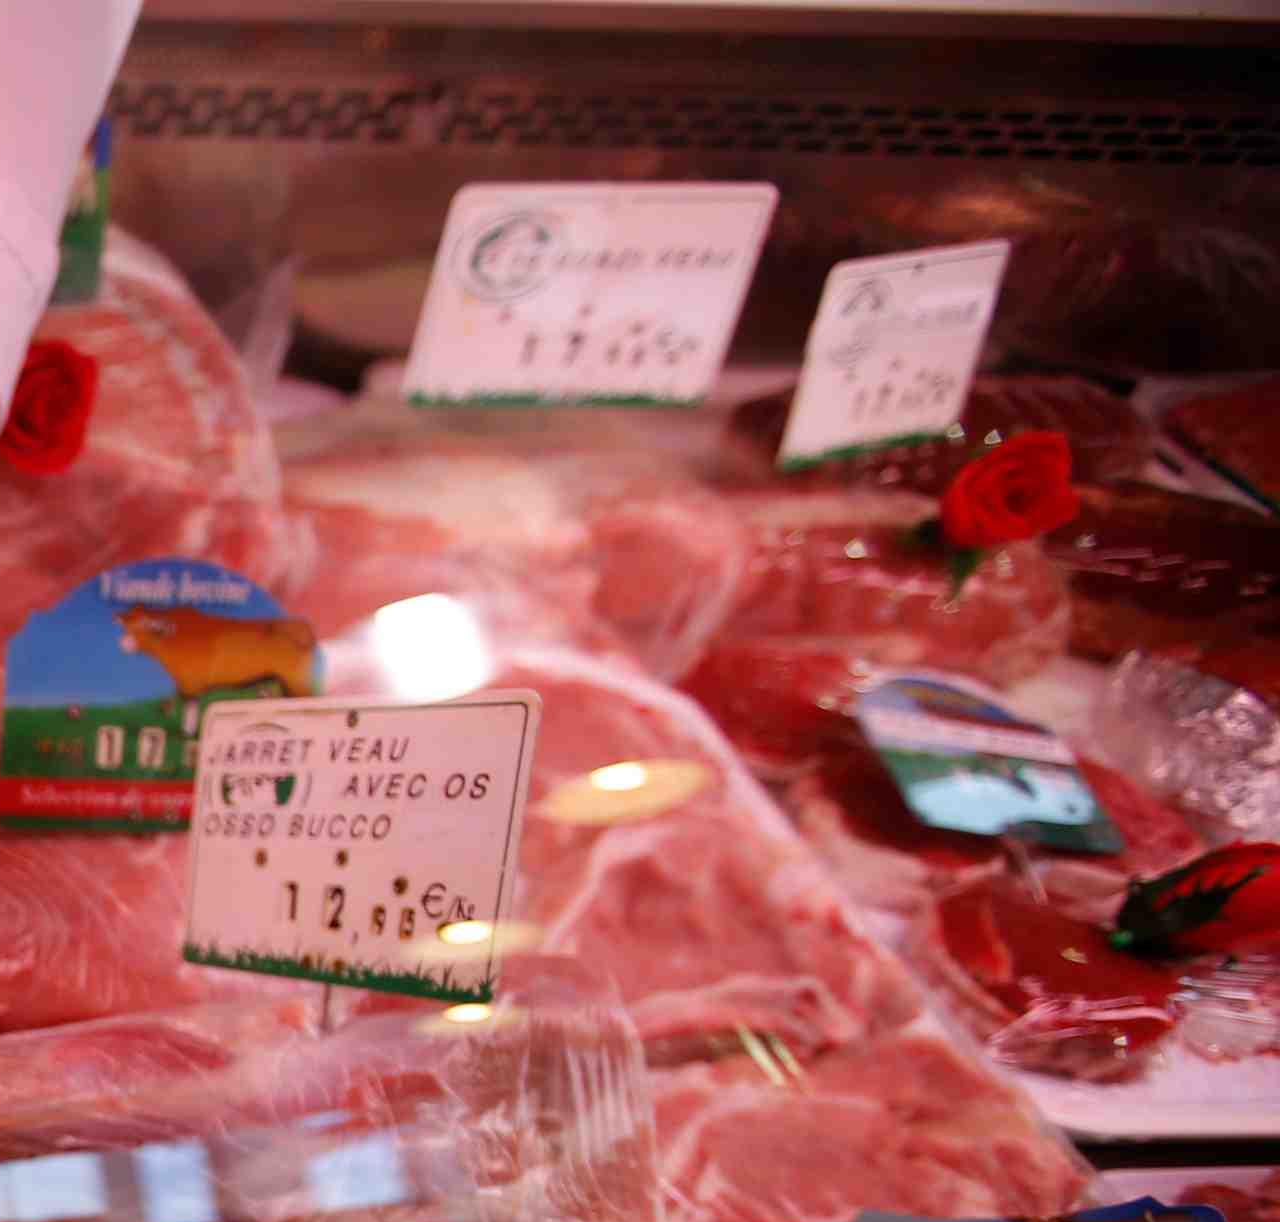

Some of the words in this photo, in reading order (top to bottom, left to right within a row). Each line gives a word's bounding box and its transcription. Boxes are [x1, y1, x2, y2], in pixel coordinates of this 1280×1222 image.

[207, 739, 313, 766] JARRET
[329, 737, 410, 764] VEAU
[343, 773, 428, 799] AVEC
[444, 773, 491, 800] OS
[204, 815, 276, 840] OSSO
[288, 814, 392, 840] BUCCO
